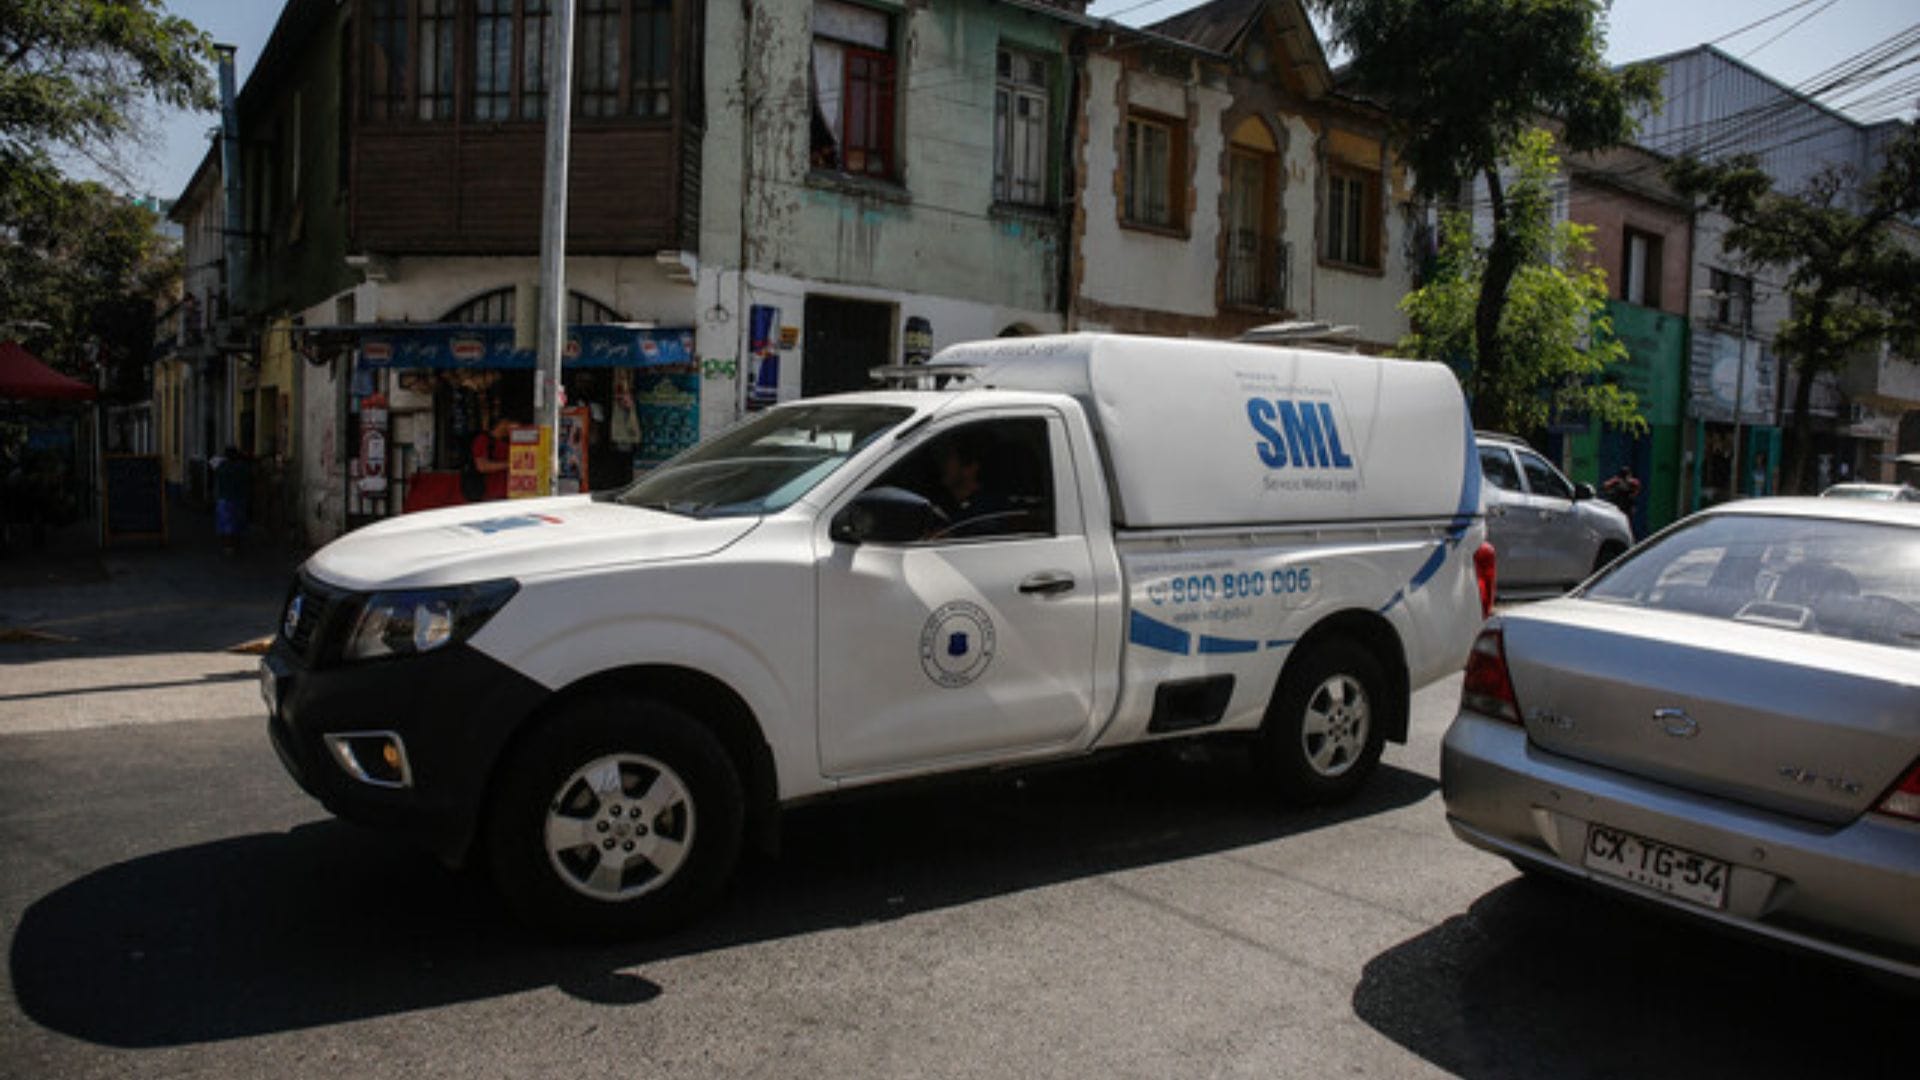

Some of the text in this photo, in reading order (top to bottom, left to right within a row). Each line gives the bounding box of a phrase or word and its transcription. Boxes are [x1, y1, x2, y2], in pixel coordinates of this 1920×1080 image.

[1247, 398, 1352, 469] SML
[1171, 567, 1312, 604] 800 800 006
